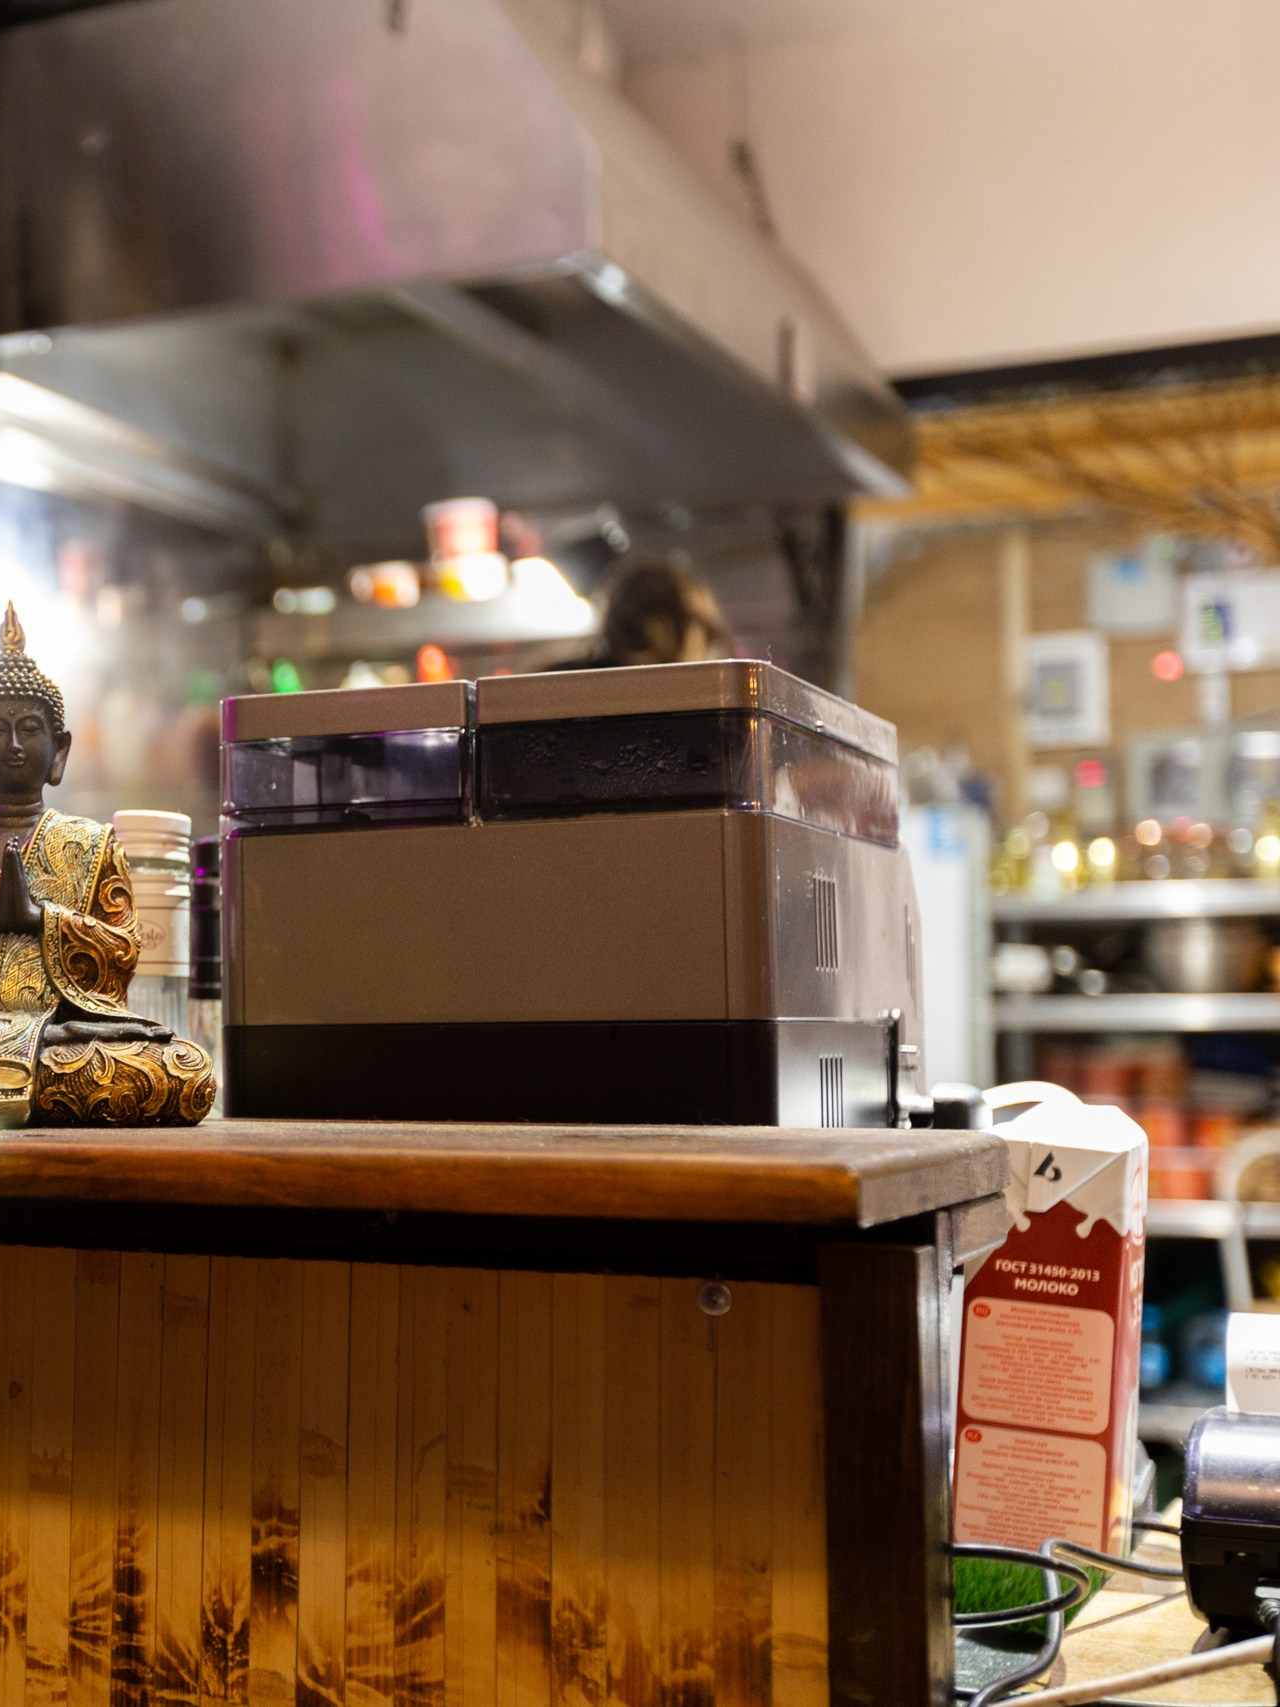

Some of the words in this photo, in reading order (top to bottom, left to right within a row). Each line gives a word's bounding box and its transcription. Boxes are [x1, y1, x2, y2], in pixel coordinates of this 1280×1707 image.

[995, 1258, 1028, 1274] ГОСТ
[1029, 1262, 1101, 1282] 31450-2013
[1014, 1277, 1079, 1296] МОЛОКО
